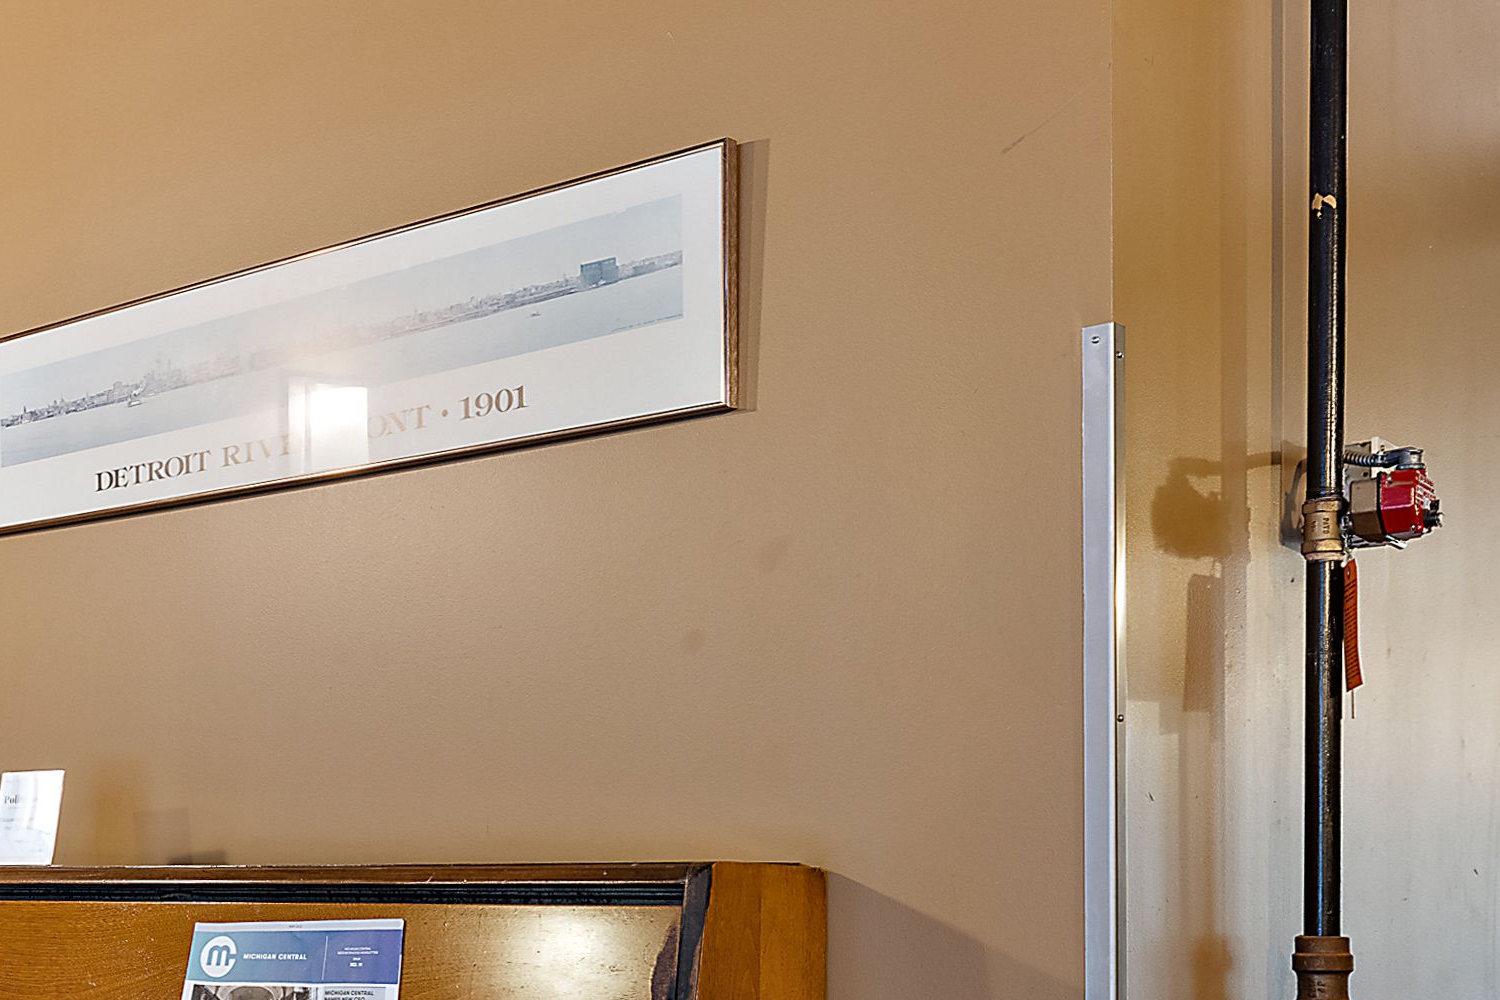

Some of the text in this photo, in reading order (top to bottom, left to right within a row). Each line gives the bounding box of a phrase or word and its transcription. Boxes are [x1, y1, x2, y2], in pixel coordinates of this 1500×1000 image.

[94, 385, 529, 492] DETROIT RIVONT 1901
[278, 953, 307, 961] CENTRAL
